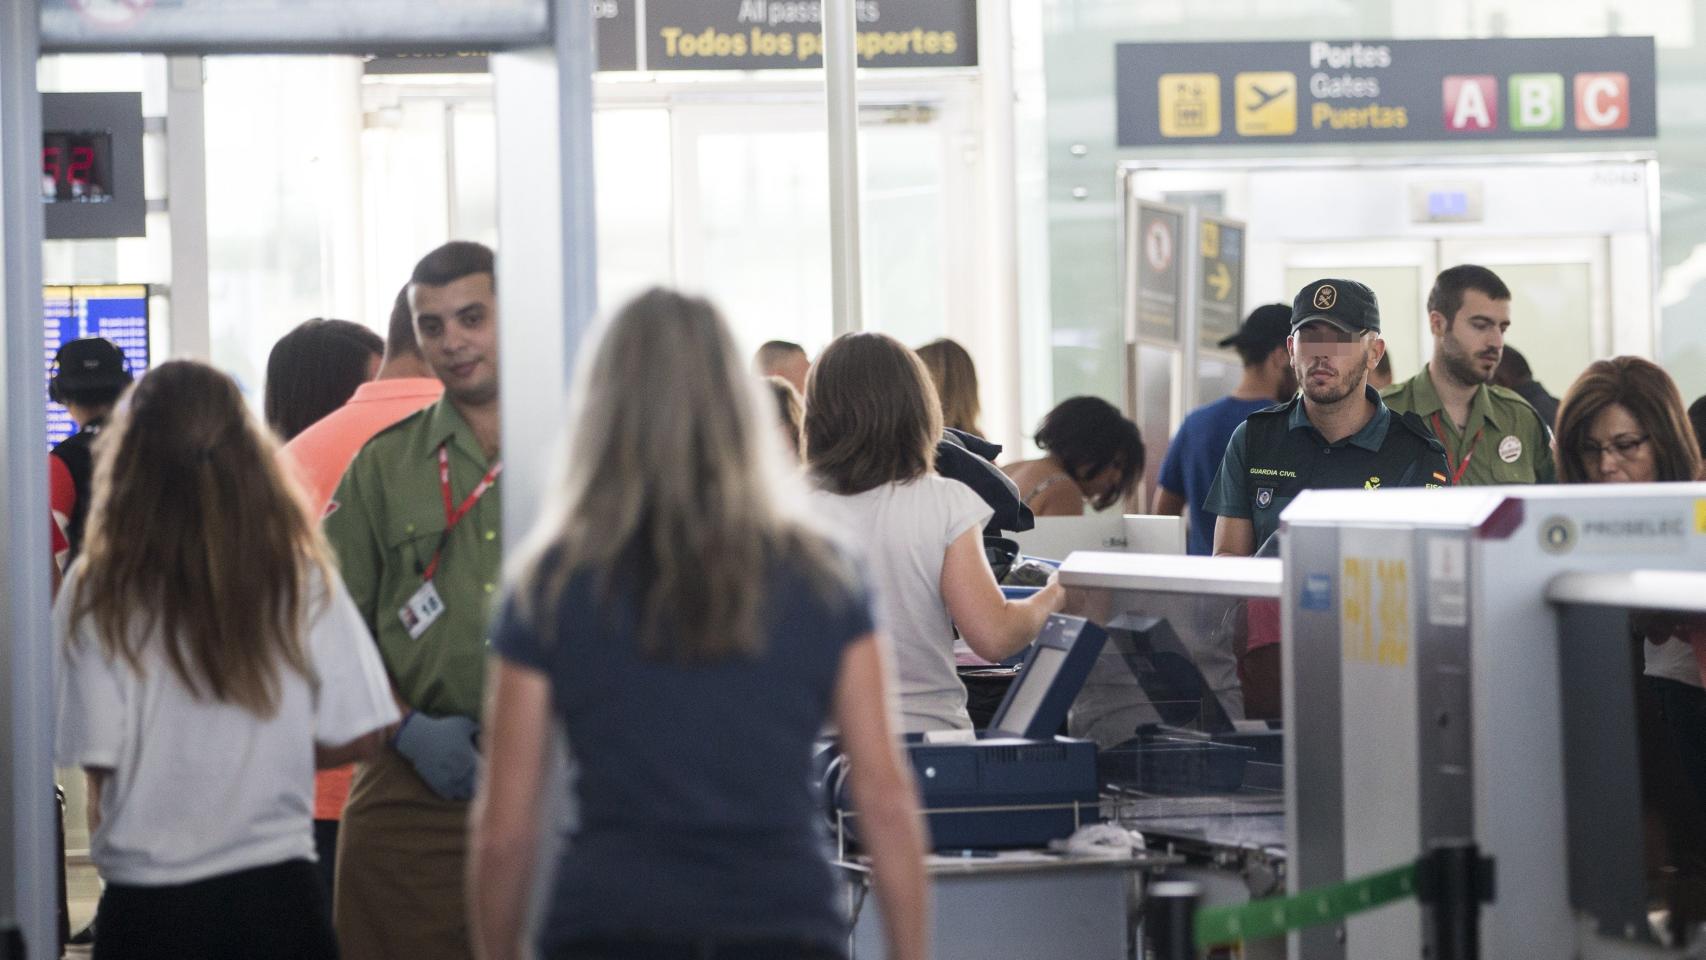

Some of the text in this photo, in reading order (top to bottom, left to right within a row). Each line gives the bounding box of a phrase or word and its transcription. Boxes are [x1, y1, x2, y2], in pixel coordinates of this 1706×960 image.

[737, 0, 767, 23] All
[660, 27, 747, 57] Todos
[751, 27, 793, 56] los
[1310, 42, 1391, 69] Portes
[1310, 72, 1380, 98] Gates
[1311, 102, 1408, 129] Puertas
[1452, 77, 1621, 129] A B C
[1249, 467, 1297, 478] GUARDIA CIVIL
